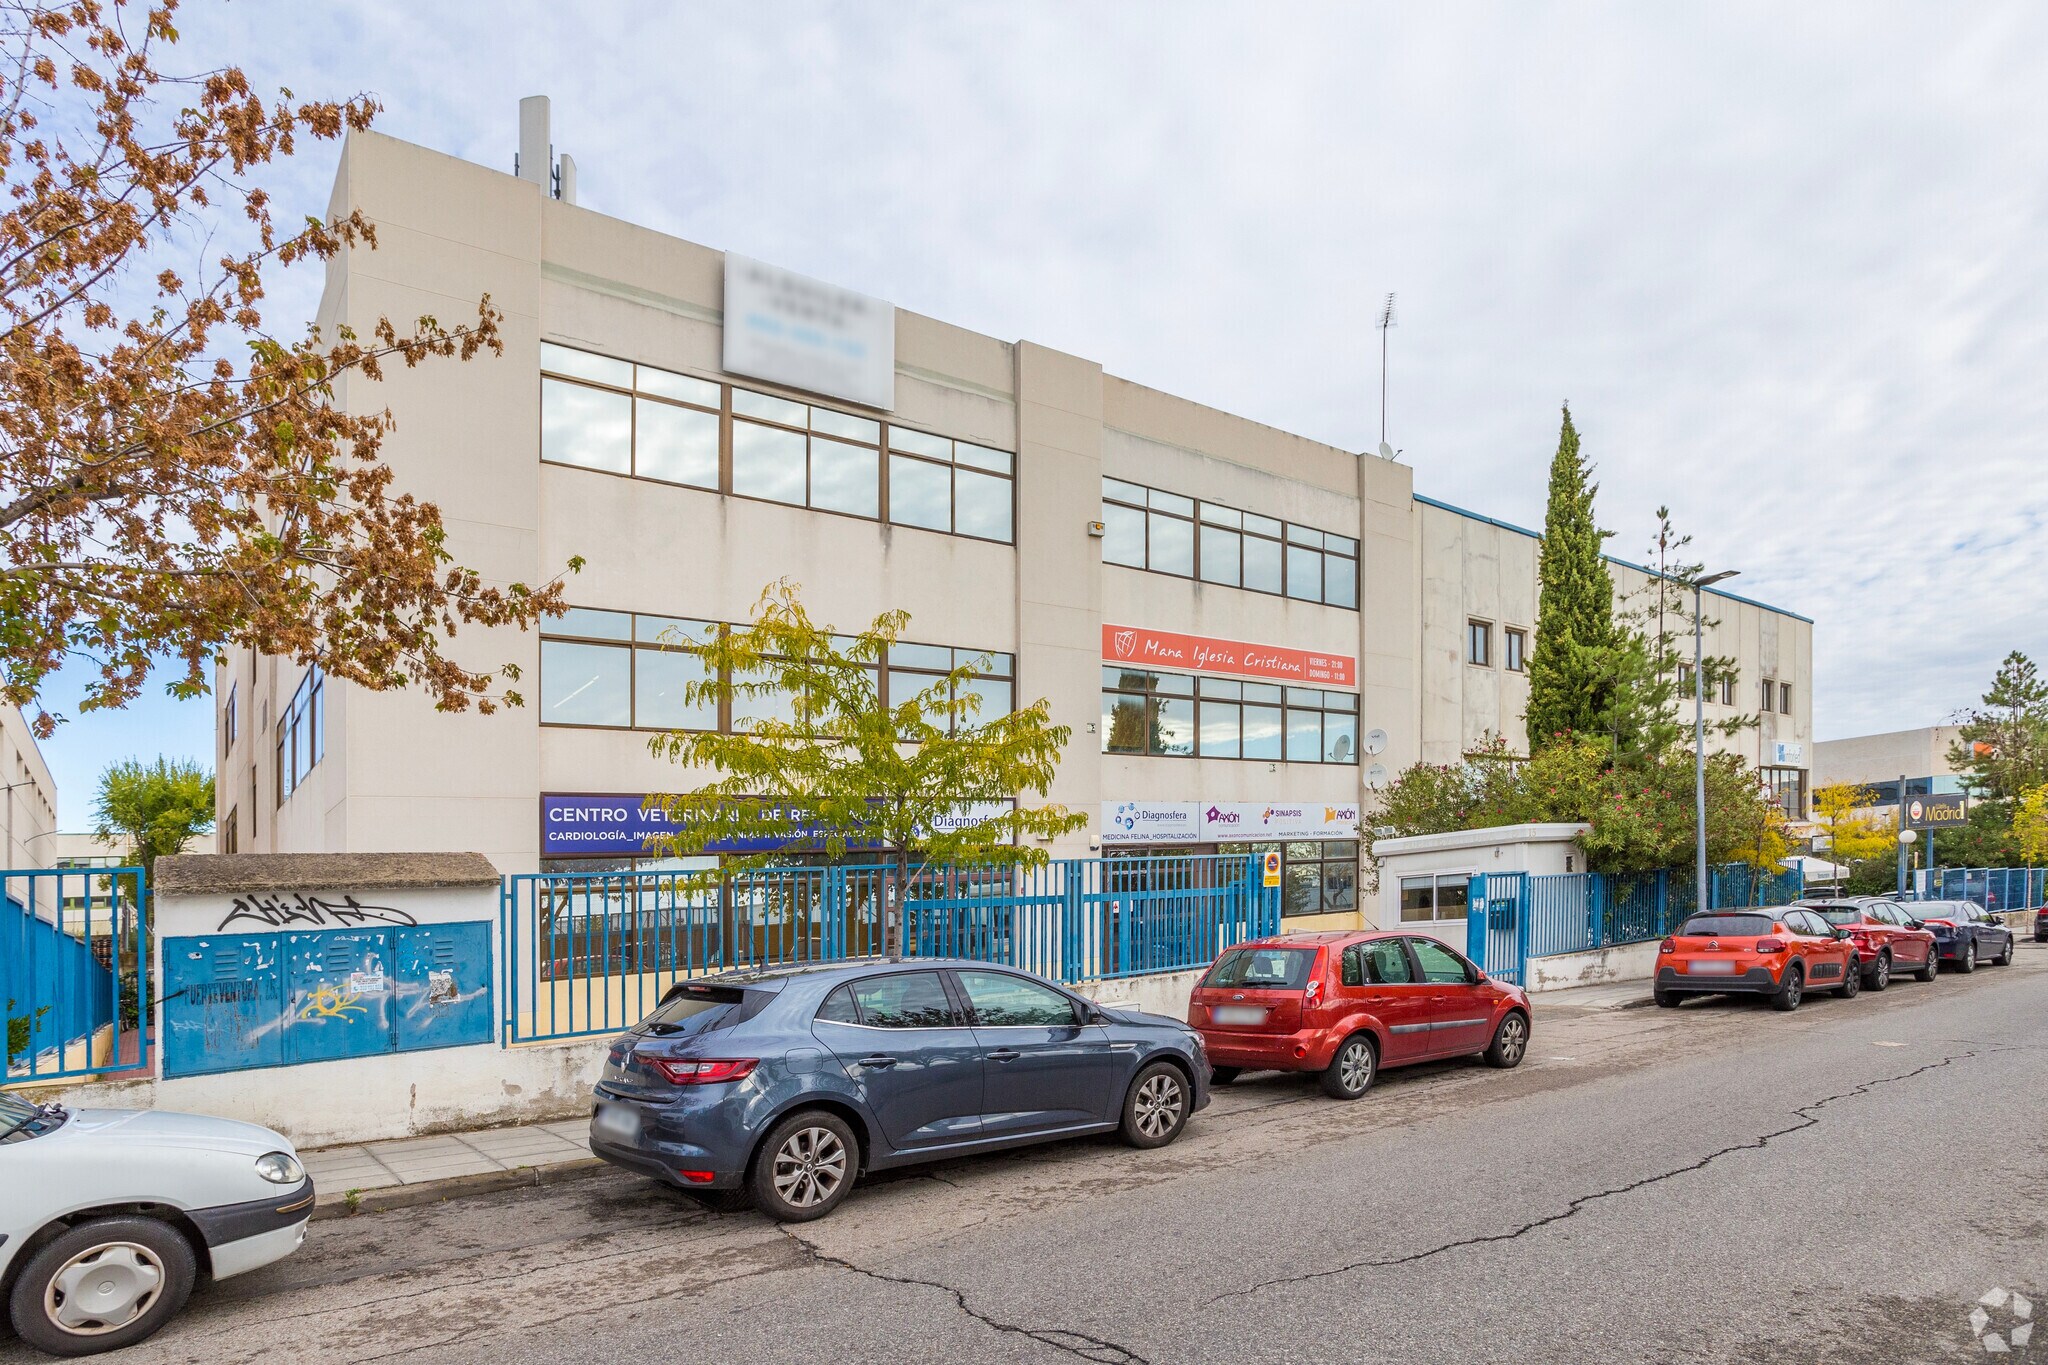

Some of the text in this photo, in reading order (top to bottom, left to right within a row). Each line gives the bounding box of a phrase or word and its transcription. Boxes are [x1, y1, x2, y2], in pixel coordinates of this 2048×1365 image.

[1144, 639, 1301, 672] Mana Iglesia Cristiana
[1309, 657, 1328, 667] VIERNES
[1309, 669, 1330, 679] DOMINGO
[549, 808, 628, 822] CENTRO
[761, 809, 781, 822] DE
[1142, 806, 1187, 822] Diagnosfera
[1218, 811, 1240, 823] AXÓN
[1275, 809, 1302, 817] SINAPSIS
[1336, 808, 1356, 820] AXÓN
[1102, 833, 1129, 841] MEDICINA
[1313, 828, 1343, 836] FORMACIÓN
